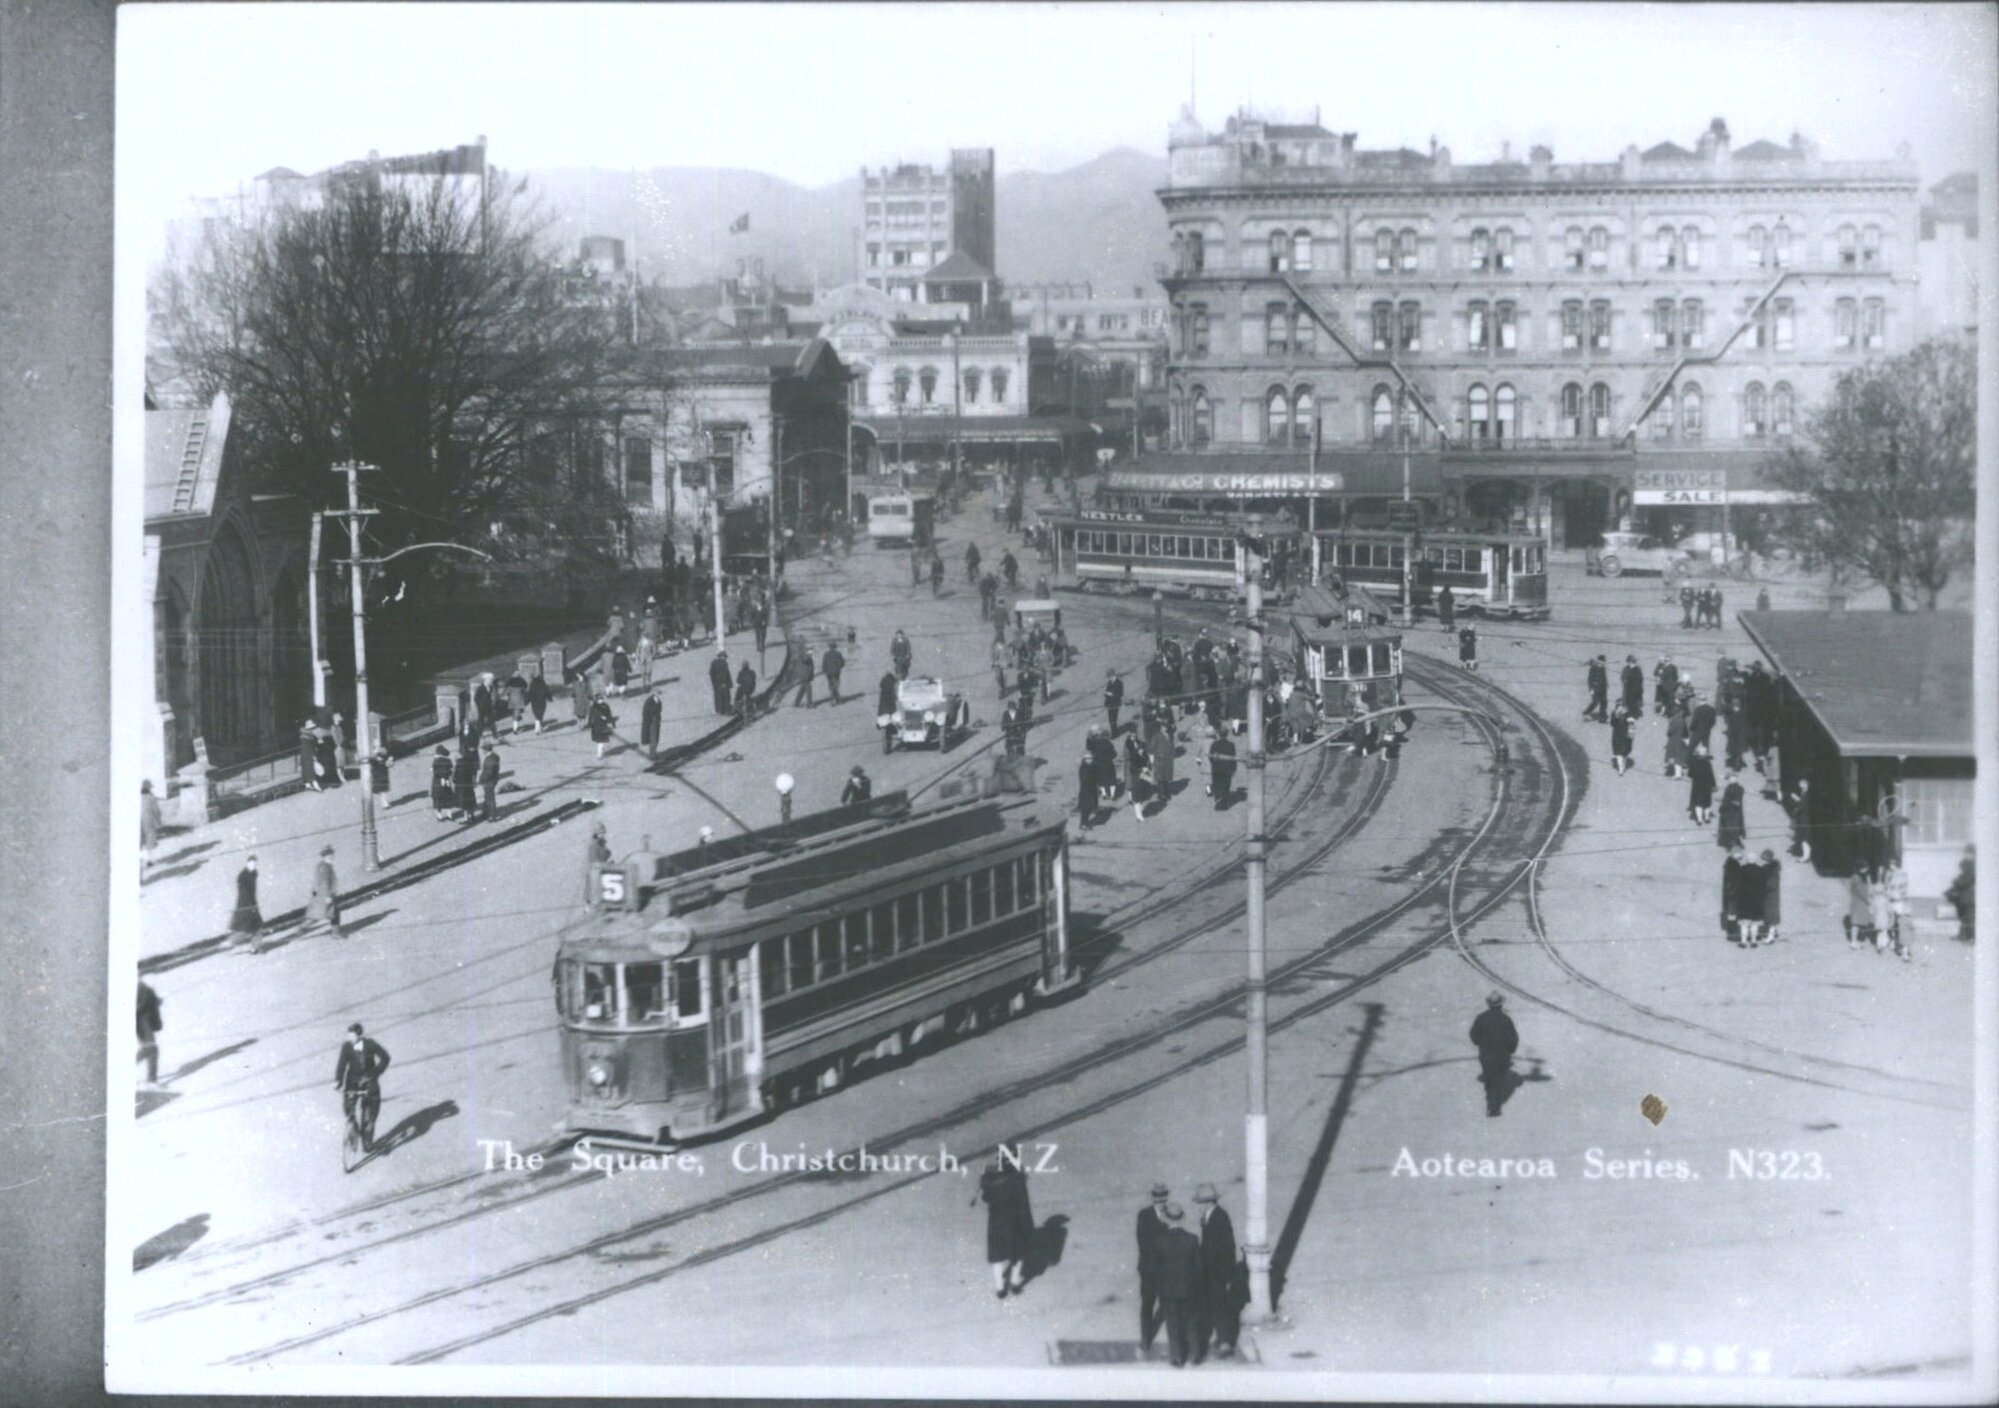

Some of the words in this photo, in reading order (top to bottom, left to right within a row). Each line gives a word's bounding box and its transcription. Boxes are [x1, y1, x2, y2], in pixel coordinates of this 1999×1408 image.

[1213, 474, 1335, 489] CHEMISTS
[1637, 473, 1721, 487] SERVICE
[1663, 491, 1721, 503] SALE
[1347, 609, 1362, 623] 14
[601, 874, 624, 901] 5
